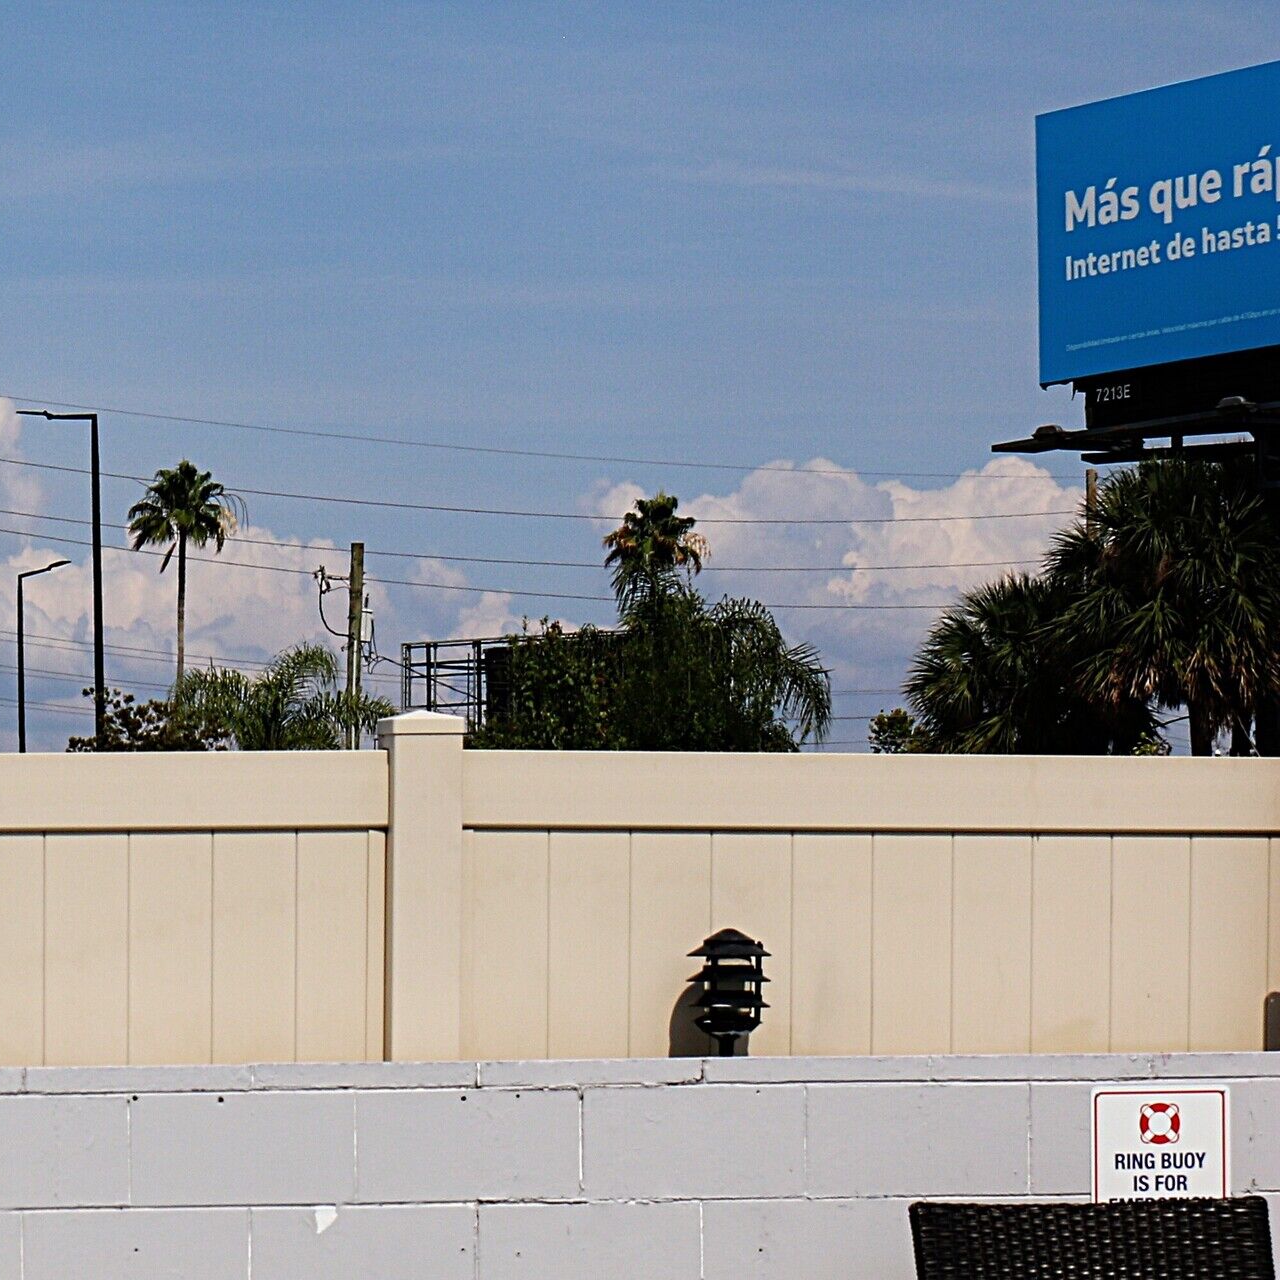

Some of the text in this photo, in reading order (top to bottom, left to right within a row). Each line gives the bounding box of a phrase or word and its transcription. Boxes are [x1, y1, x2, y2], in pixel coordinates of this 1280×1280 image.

[1065, 144, 1280, 232] Más que rá
[1065, 240, 1161, 281] Internet
[1167, 232, 1195, 261] de
[1202, 220, 1271, 255] hasta
[1096, 384, 1131, 402] 7213E
[1114, 1152, 1206, 1170] RING BUOY
[1133, 1174, 1188, 1192] IS FOR
